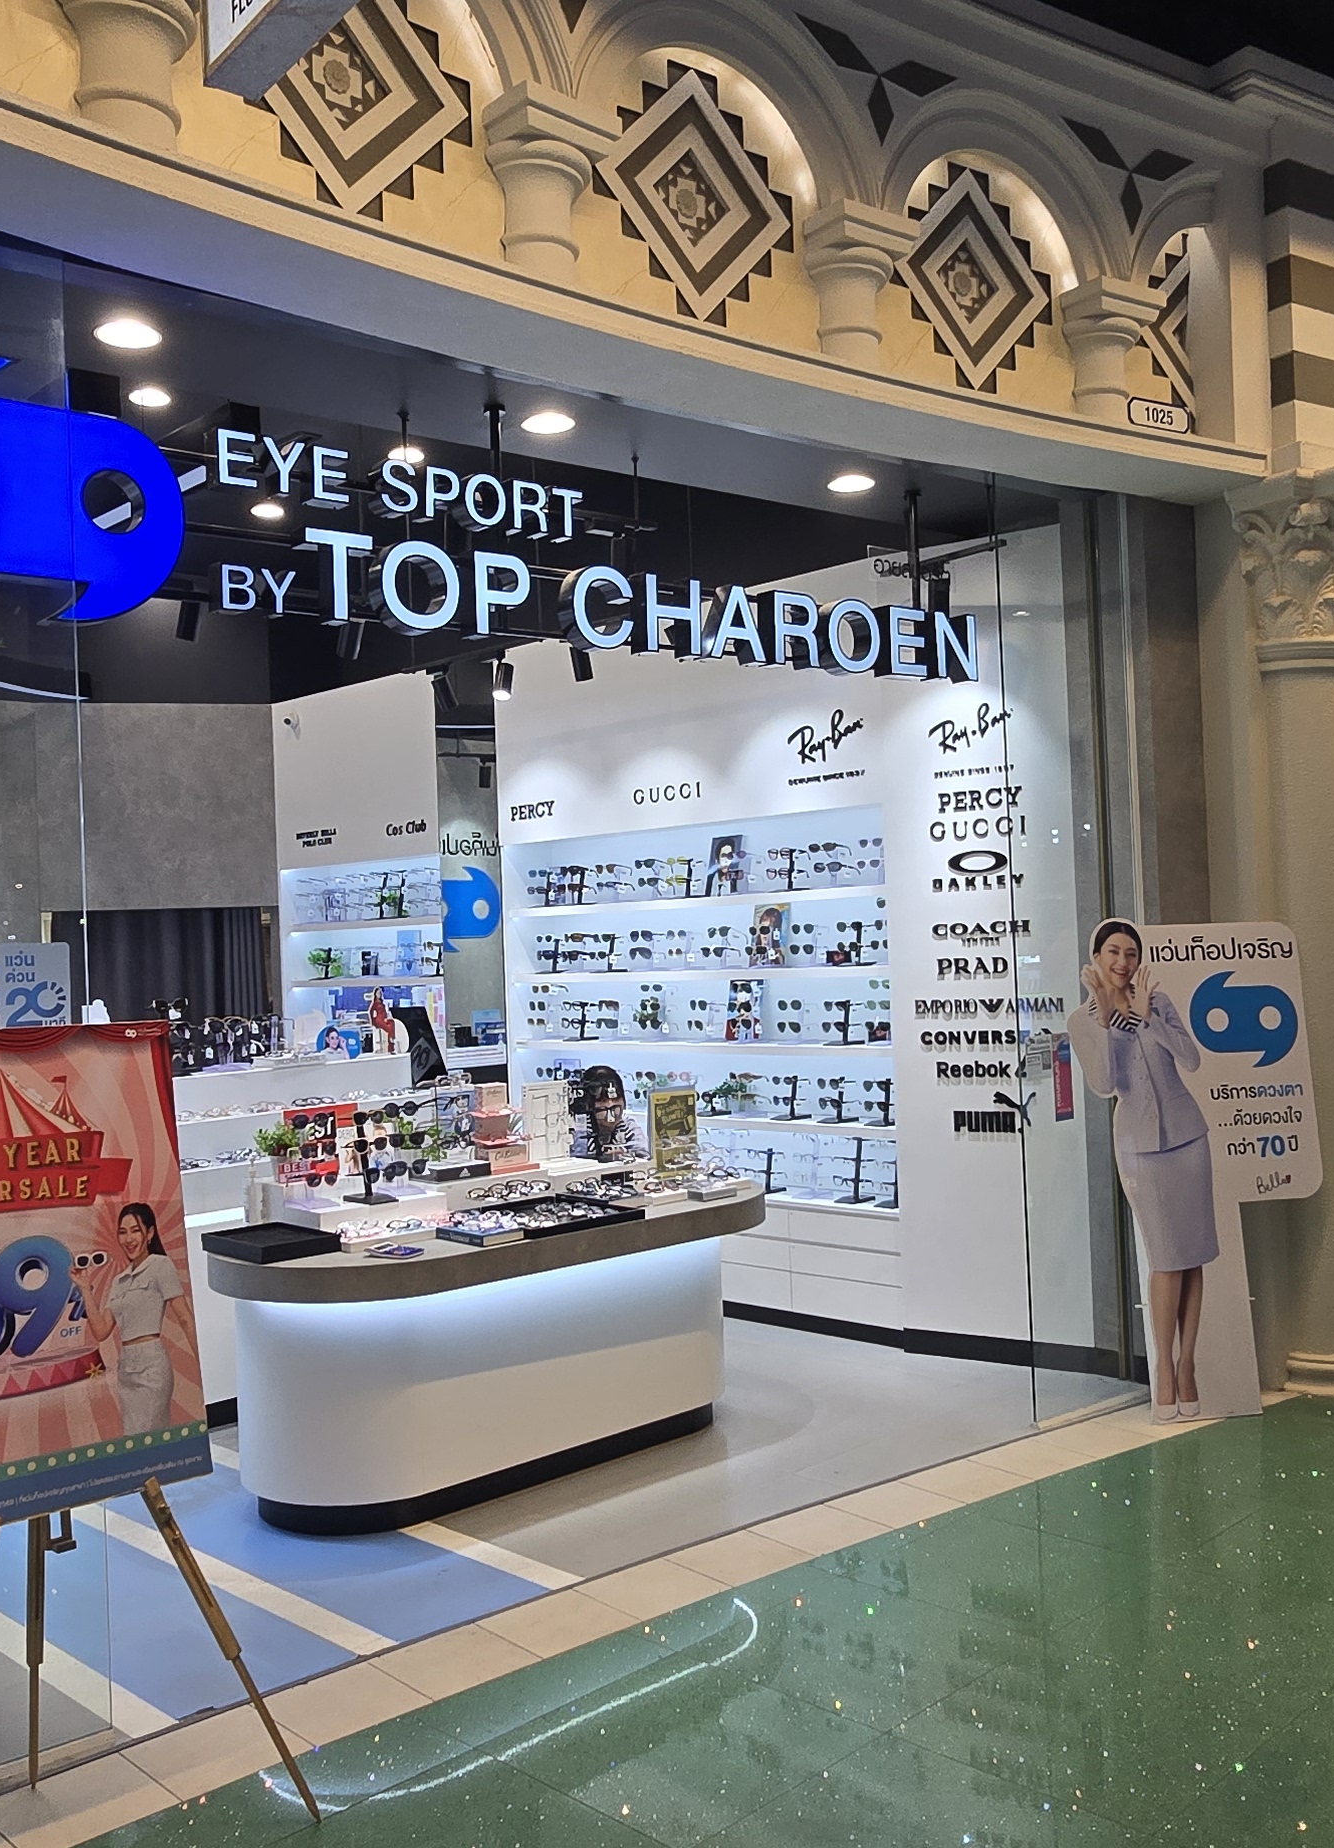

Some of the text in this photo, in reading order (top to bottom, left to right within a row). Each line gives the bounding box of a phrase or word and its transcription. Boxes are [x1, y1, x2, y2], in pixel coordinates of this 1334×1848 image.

[1145, 407, 1173, 426] 1025
[216, 428, 584, 538] EYE SPORT
[221, 527, 979, 682] BY TOP CHAROEN
[633, 781, 702, 805] GUCCI
[938, 785, 1023, 814] PERCY
[510, 800, 555, 822] PERCY
[386, 819, 427, 836] Cos Club
[930, 814, 1027, 842] GUCCI
[932, 919, 1030, 937] COACH
[5, 950, 35, 967] แว่น
[1149, 936, 1294, 963] แว่นท็อปเจริญ
[5, 970, 36, 983] ด่วน
[914, 997, 1065, 1014] EMPORIO ARMANI
[937, 1061, 1011, 1079] Reebok
[1209, 1084, 1304, 1101] บริการดวงตา
[952, 1110, 1016, 1133] PUMA
[3, 1138, 81, 1168] YEAR
[1226, 1134, 1299, 1157] กว่า 70 ปี
[60, 1326, 82, 1338] OFF
